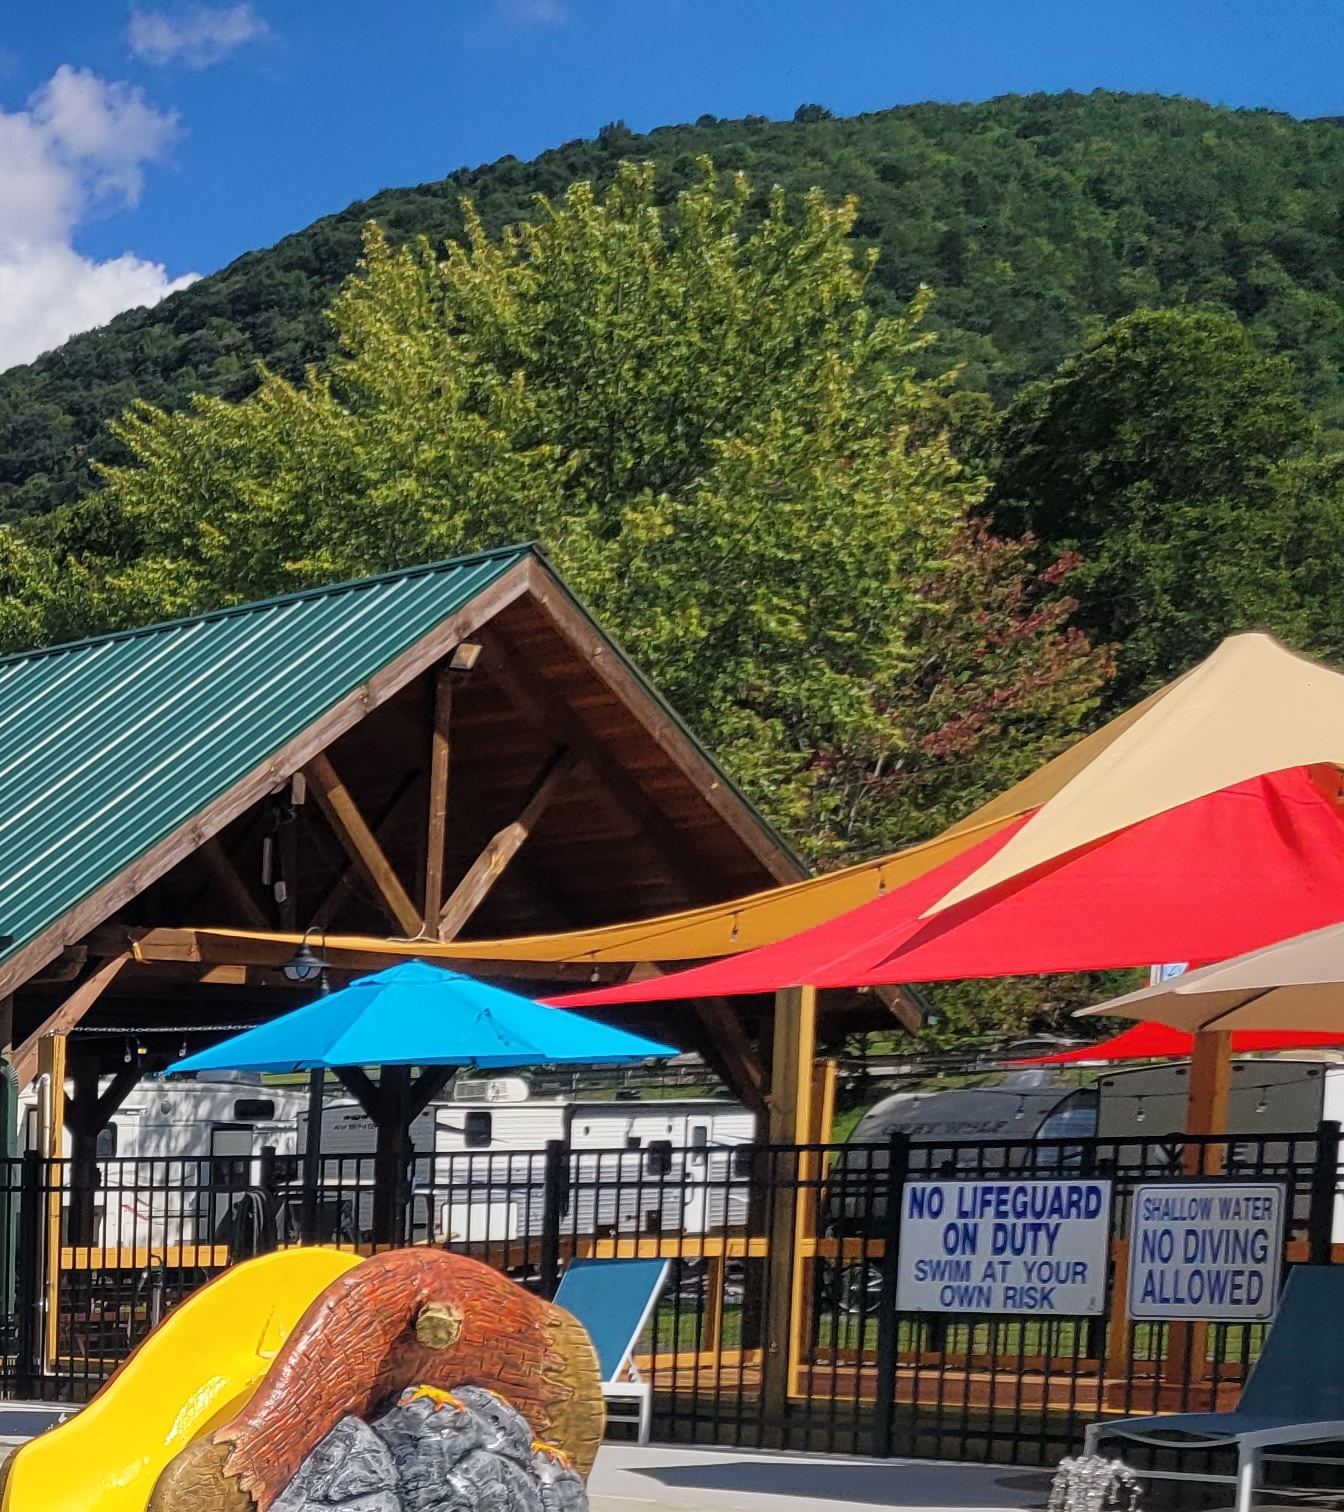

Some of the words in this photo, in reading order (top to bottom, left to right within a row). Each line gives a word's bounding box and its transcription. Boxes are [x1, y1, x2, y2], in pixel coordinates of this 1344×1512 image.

[908, 1186, 944, 1219] NO
[956, 1185, 1103, 1220] LIFEGUARD
[1143, 1197, 1211, 1222] SHALLOW
[1217, 1197, 1273, 1221] WATER
[943, 1223, 978, 1256] ON
[991, 1222, 1062, 1256] DUTY
[1140, 1229, 1175, 1264] NO
[1185, 1228, 1269, 1264] DIVING
[914, 1260, 972, 1284] SWIM
[983, 1261, 1012, 1284] AT
[1023, 1260, 1088, 1285] YOUR
[1139, 1268, 1264, 1306] ALLOWED
[939, 1285, 994, 1309] OWN
[1002, 1287, 1057, 1310] RISK
